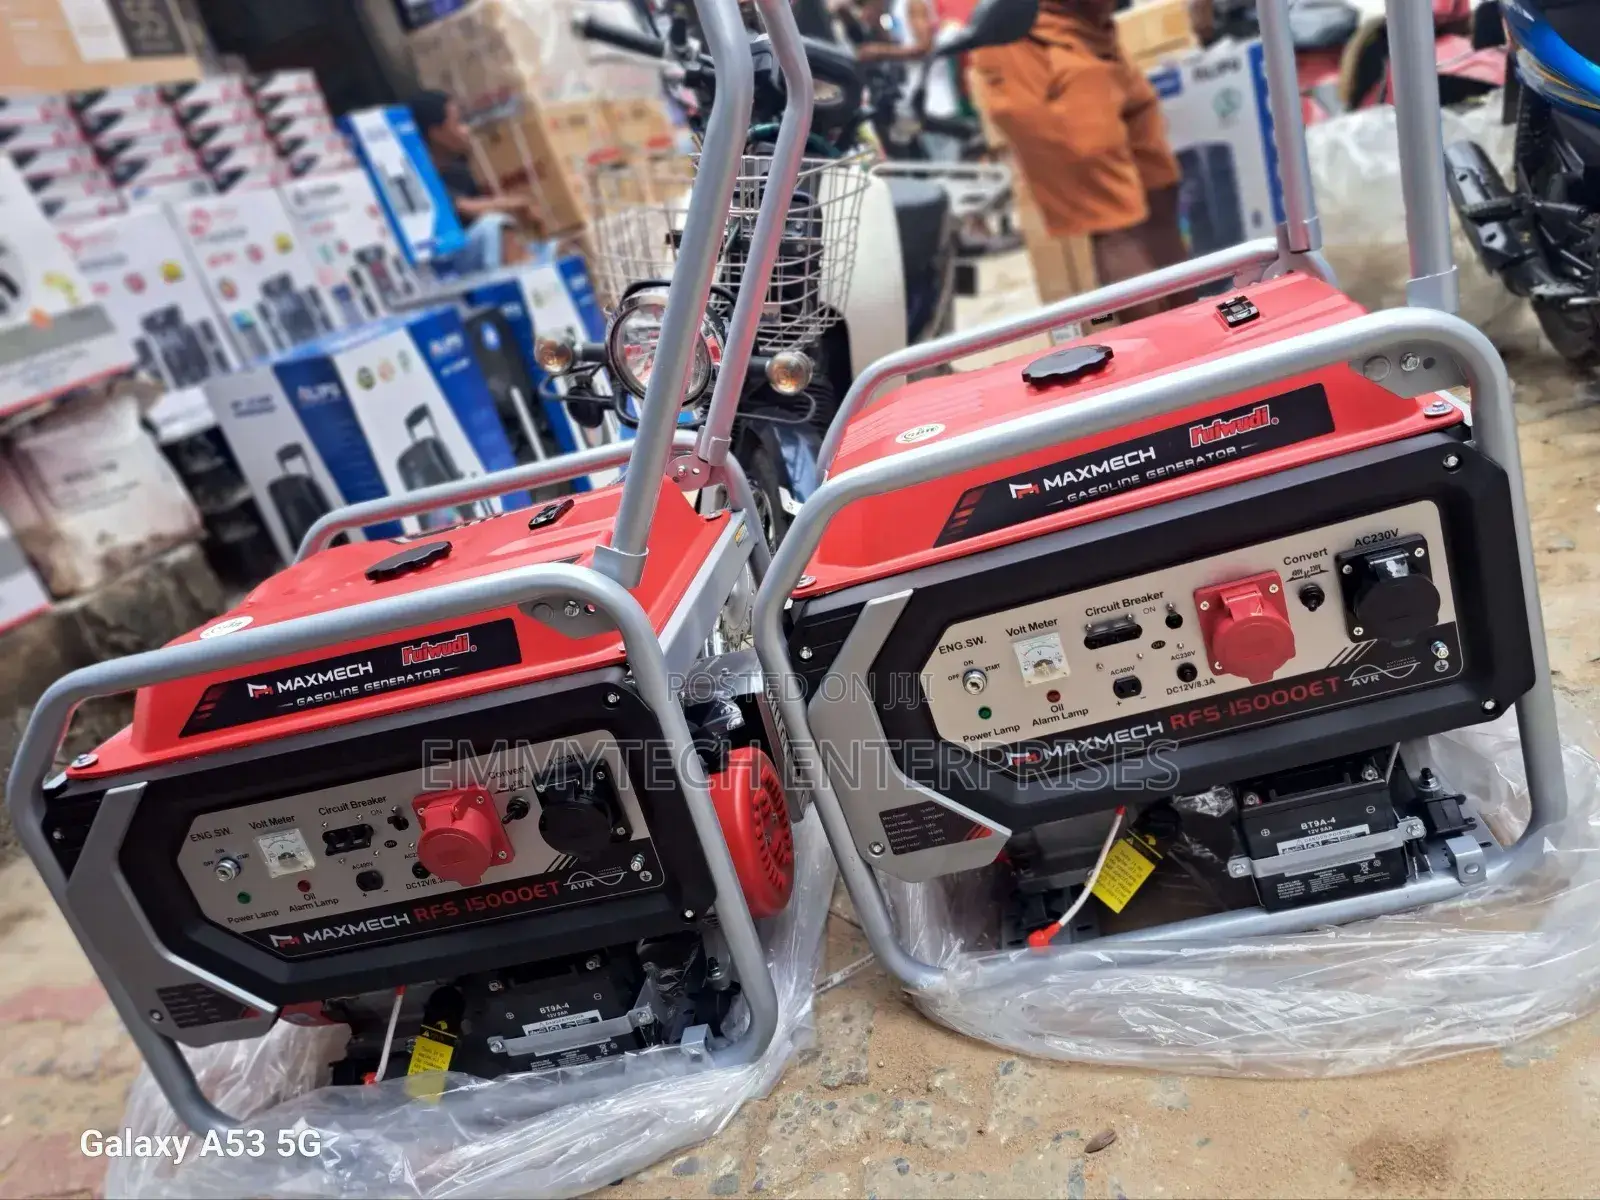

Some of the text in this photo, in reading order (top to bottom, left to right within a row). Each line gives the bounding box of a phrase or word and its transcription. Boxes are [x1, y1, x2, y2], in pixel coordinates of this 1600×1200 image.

[1044, 446, 1156, 492] MAXMECH
[1067, 446, 1238, 503] GASOLINE GENERATOR
[1354, 527, 1399, 548] AC230V
[1283, 547, 1328, 566] Convert
[1085, 589, 1164, 618] Circuit Breaker
[1142, 605, 1157, 615] ON
[1005, 617, 1058, 638] Volt Meter
[938, 635, 987, 655] ENG.SW.
[963, 658, 974, 667] ON
[1170, 650, 1196, 662] AC230V
[276, 660, 373, 694] MAXMECH
[985, 663, 1001, 673] START
[1110, 664, 1136, 677] AC400V
[296, 667, 441, 707] GASOLINE GENERATOR
[1165, 677, 1216, 696] DC12V/8.3A
[1351, 673, 1380, 687] AVR
[1032, 706, 1089, 727] Alarm Lamp
[1050, 703, 1064, 714] Oil
[962, 722, 1021, 743] Power Lamp
[1044, 720, 1164, 761] MAXMECH
[488, 765, 528, 780] Convert
[318, 794, 388, 817] Circuit Breaker
[370, 808, 382, 816] ON
[249, 813, 296, 831] Volt Meter
[1300, 816, 1337, 831] BT9A-4
[570, 880, 595, 891] AVR
[289, 895, 340, 913] Alarm Lamp
[303, 892, 316, 901] Oil
[227, 908, 279, 925] Power Lamp
[303, 913, 411, 944] MAXMECH
[539, 1002, 570, 1014] BT9A-4
